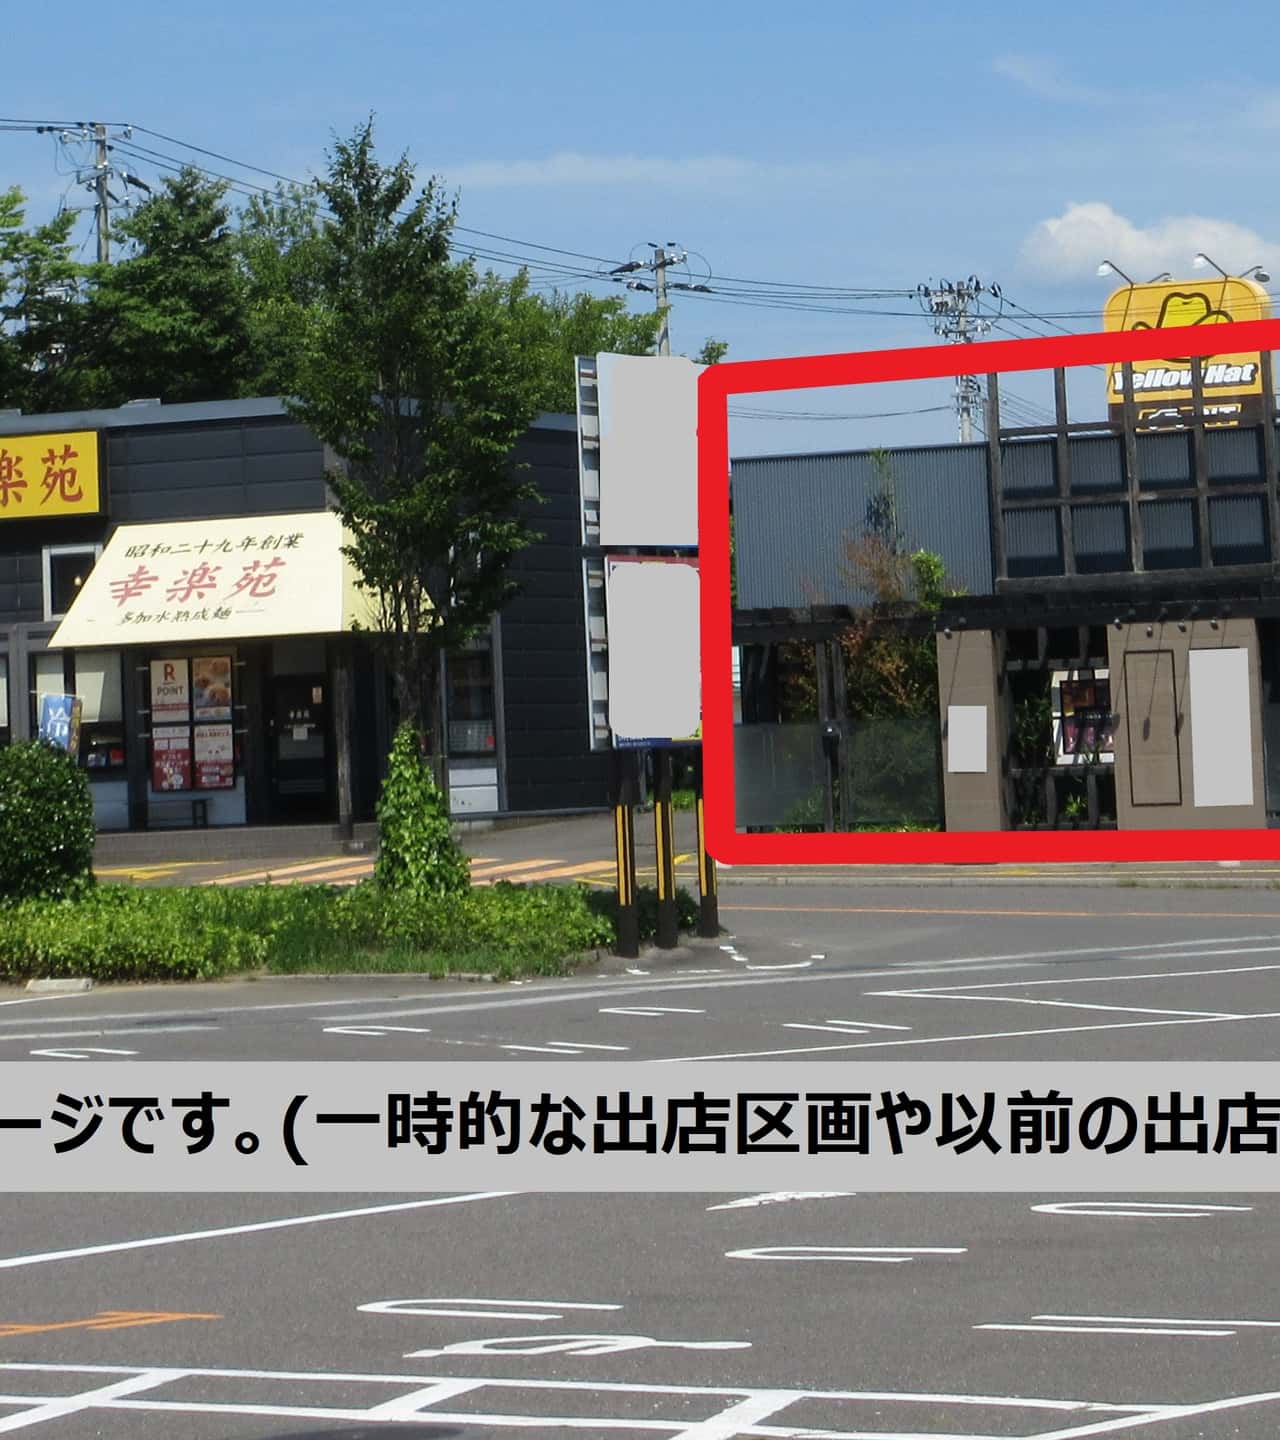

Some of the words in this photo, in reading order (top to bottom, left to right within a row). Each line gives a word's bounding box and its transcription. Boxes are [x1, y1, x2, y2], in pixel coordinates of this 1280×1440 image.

[125, 532, 304, 558] 昭和二十九年創業
[109, 557, 286, 607] 幸楽苑
[164, 663, 176, 680] R
[157, 686, 183, 696] POINT
